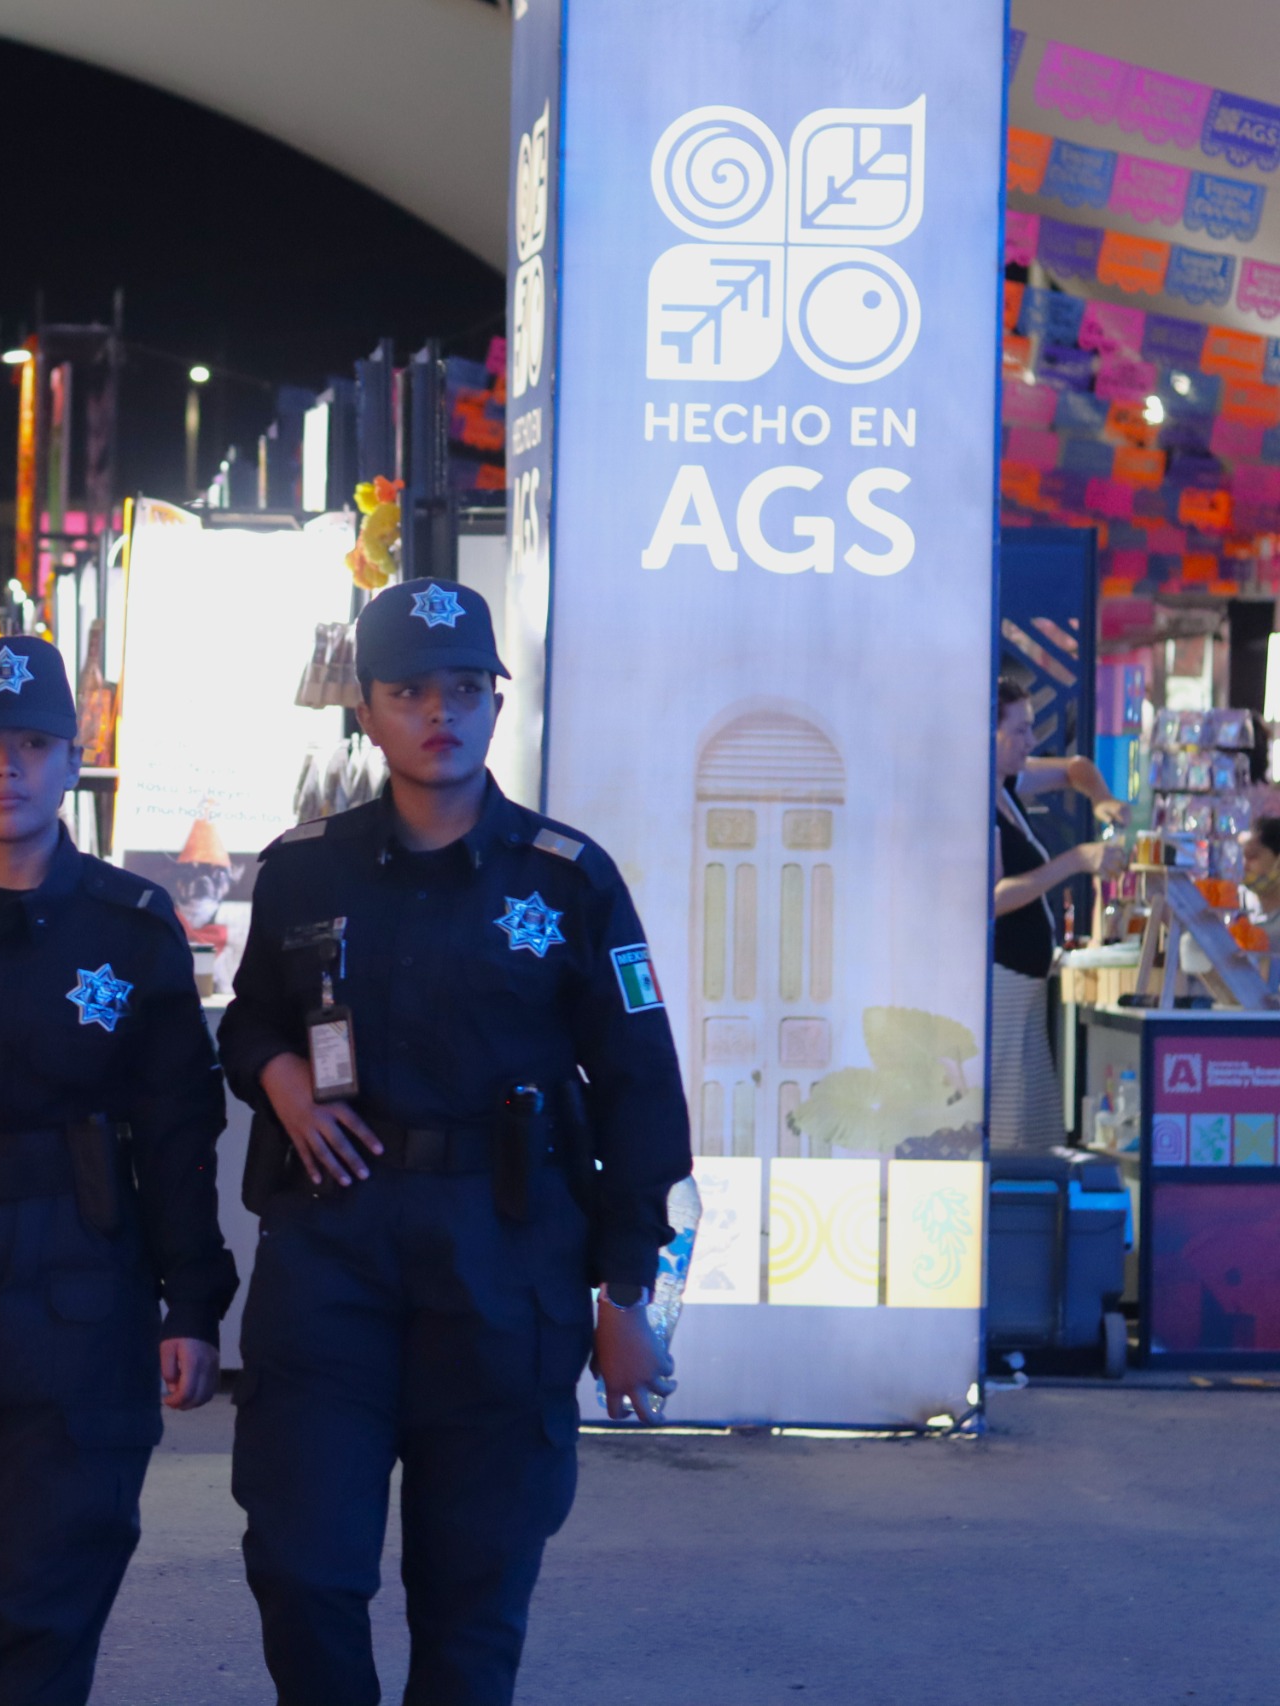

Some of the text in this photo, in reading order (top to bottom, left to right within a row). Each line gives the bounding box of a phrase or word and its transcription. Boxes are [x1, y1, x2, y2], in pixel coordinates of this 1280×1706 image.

[1237, 119, 1278, 147] AGS
[644, 402, 916, 448] HECHO EN
[641, 465, 916, 576] AGS
[146, 804, 204, 818] muchos
[617, 950, 650, 964] MEXIC
